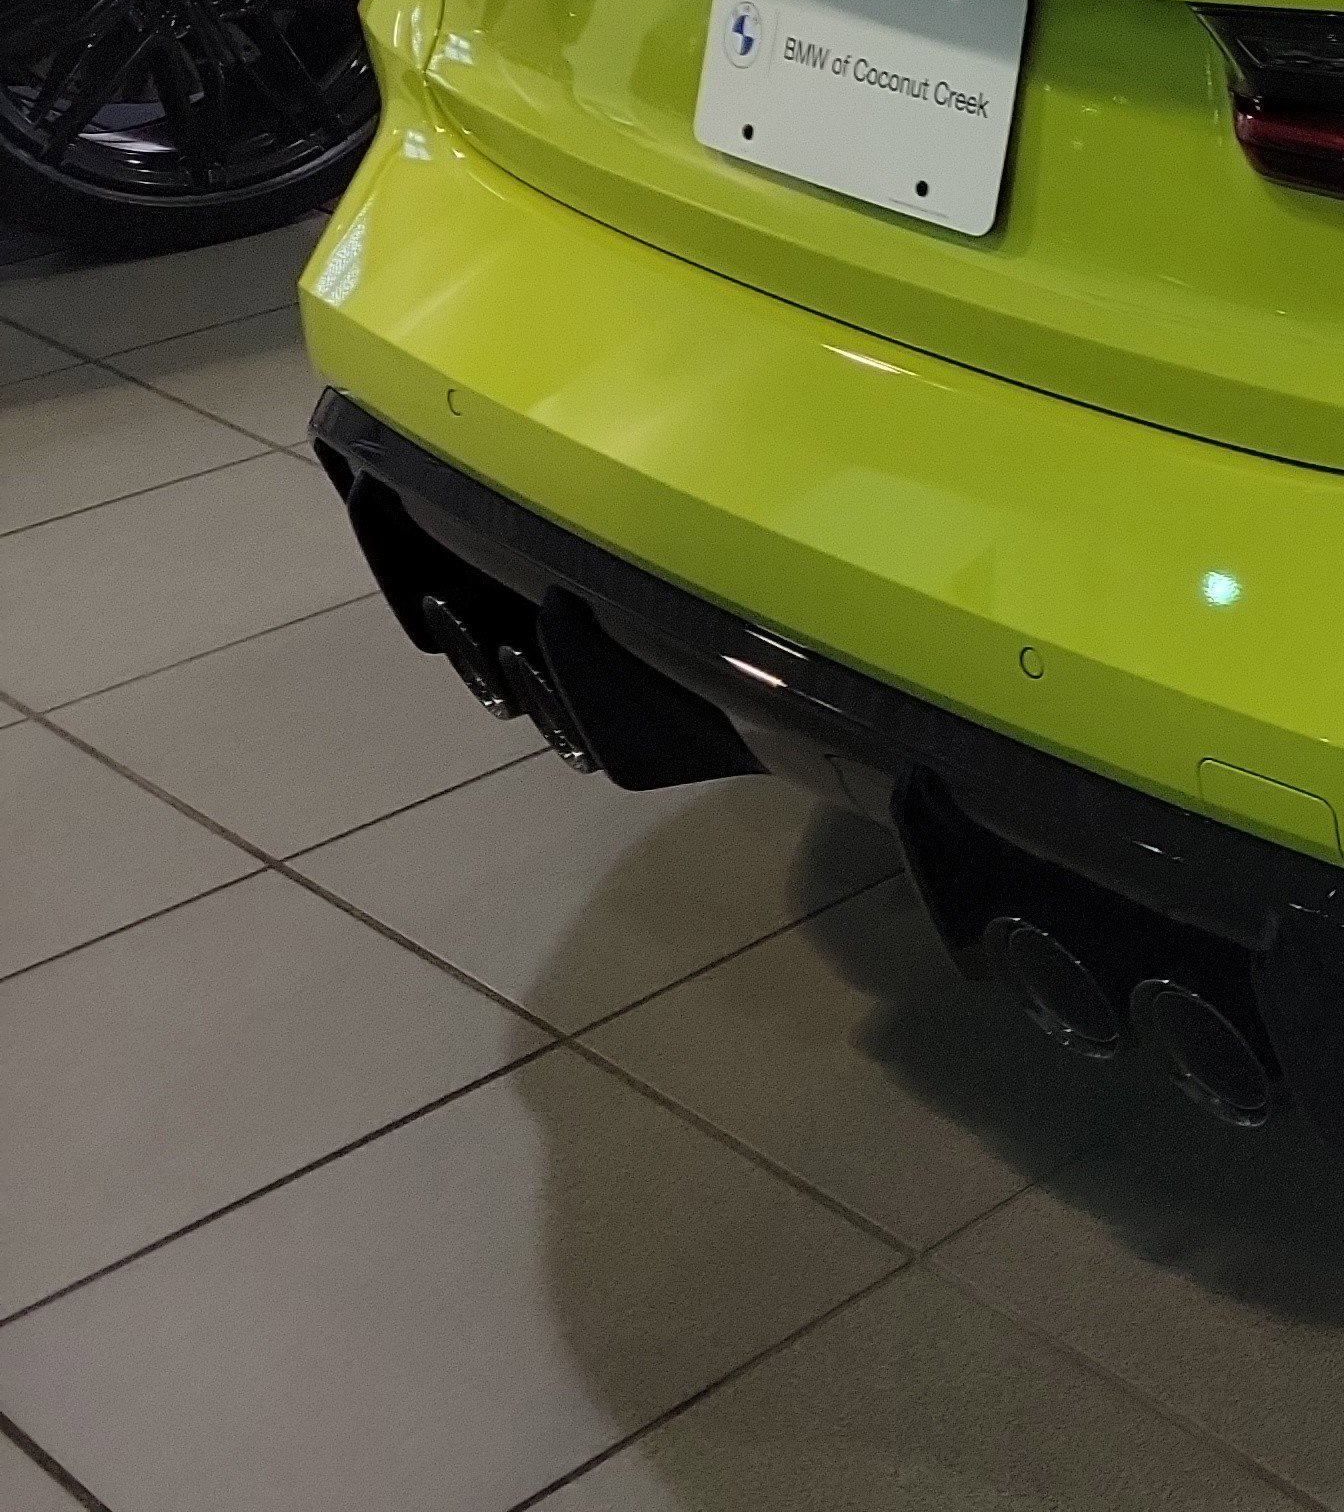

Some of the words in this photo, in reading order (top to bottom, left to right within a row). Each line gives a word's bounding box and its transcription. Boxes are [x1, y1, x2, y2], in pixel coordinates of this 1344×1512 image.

[783, 36, 831, 70] BMW
[831, 54, 852, 77] of
[853, 58, 930, 100] Coconut
[933, 81, 990, 118] Creek
